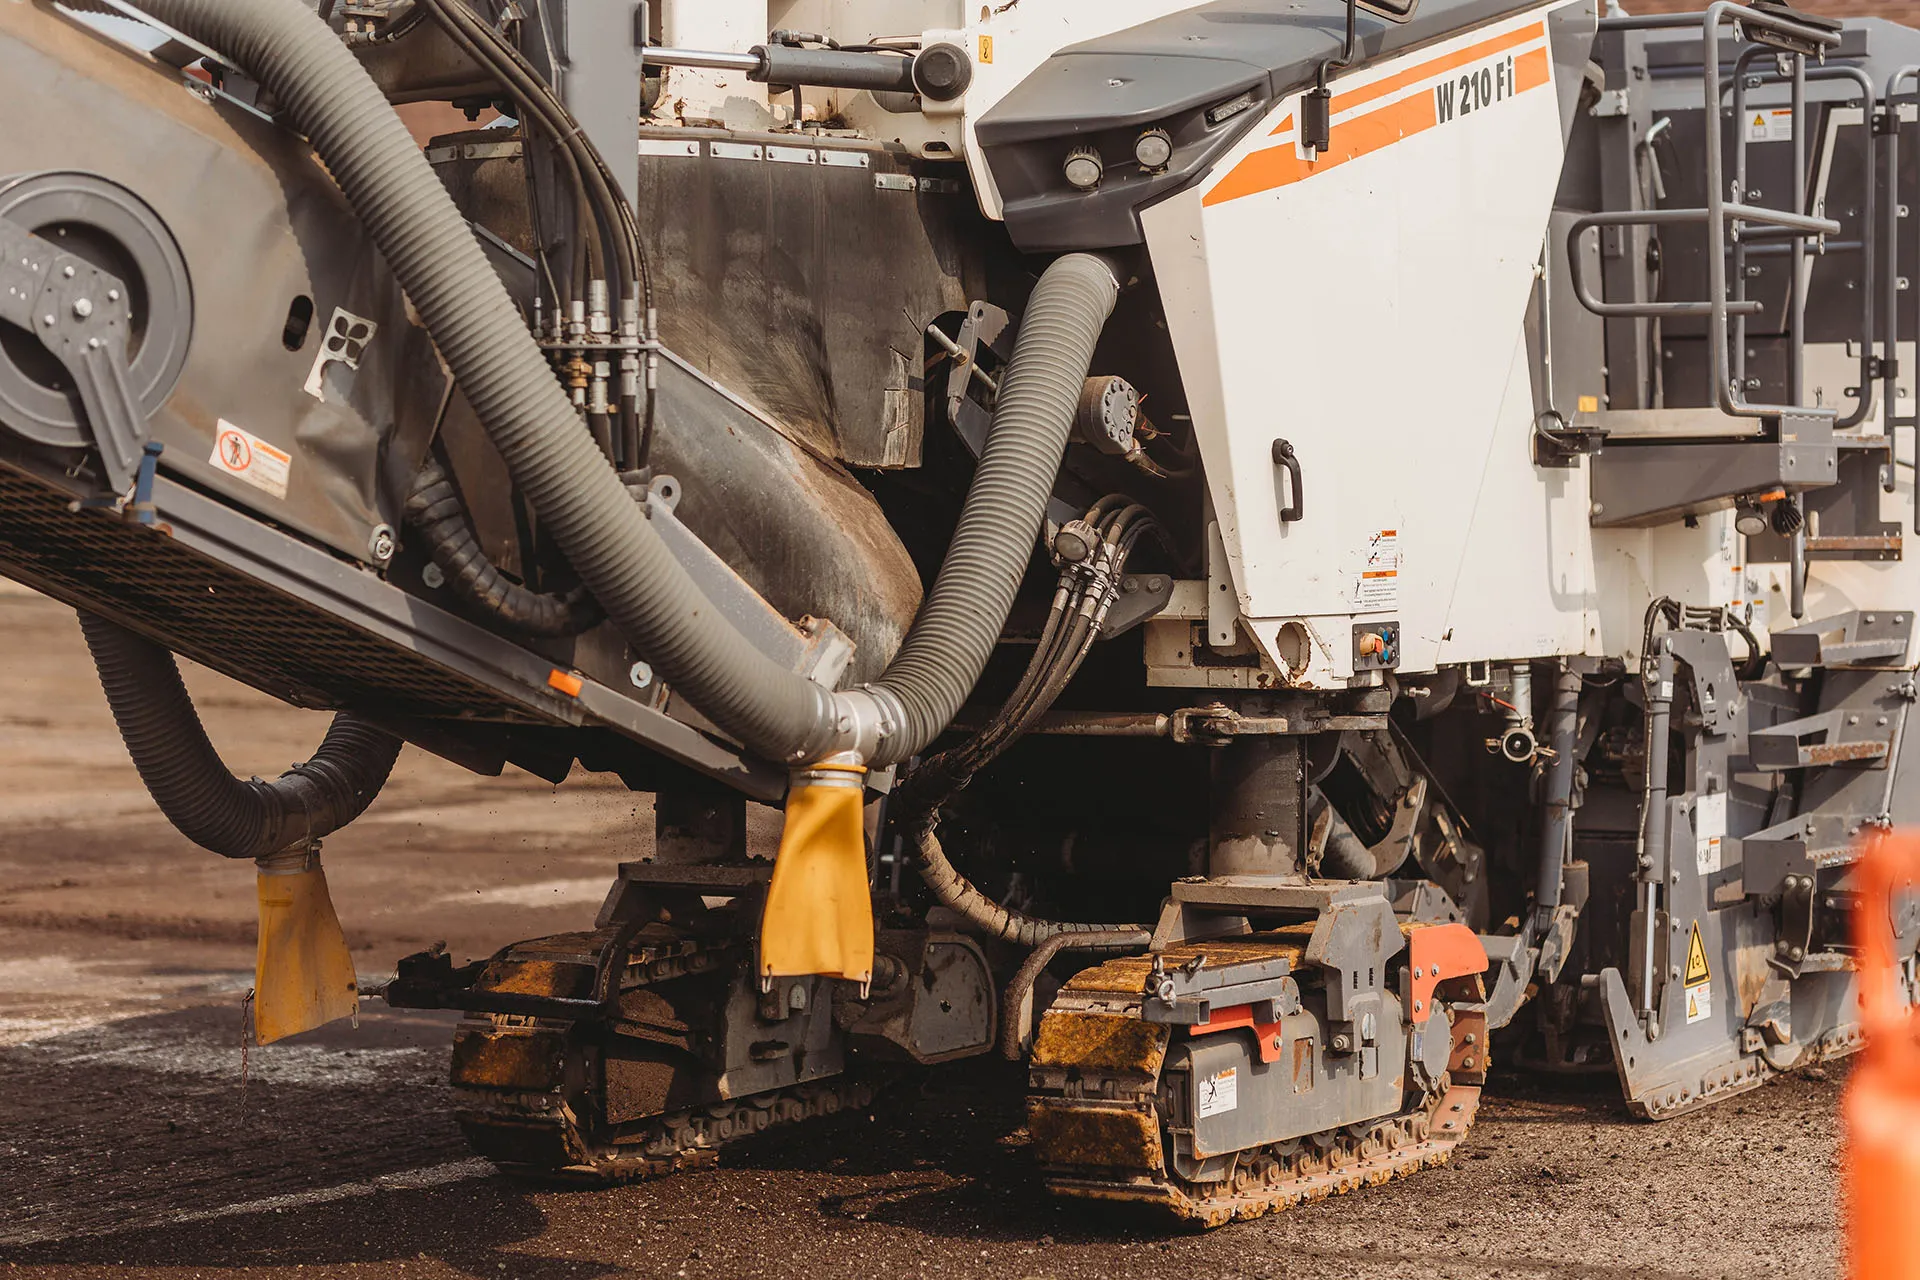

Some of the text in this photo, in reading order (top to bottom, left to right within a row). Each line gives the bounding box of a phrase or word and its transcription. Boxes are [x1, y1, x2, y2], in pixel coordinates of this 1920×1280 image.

[1437, 55, 1512, 124] W 210 Fi
